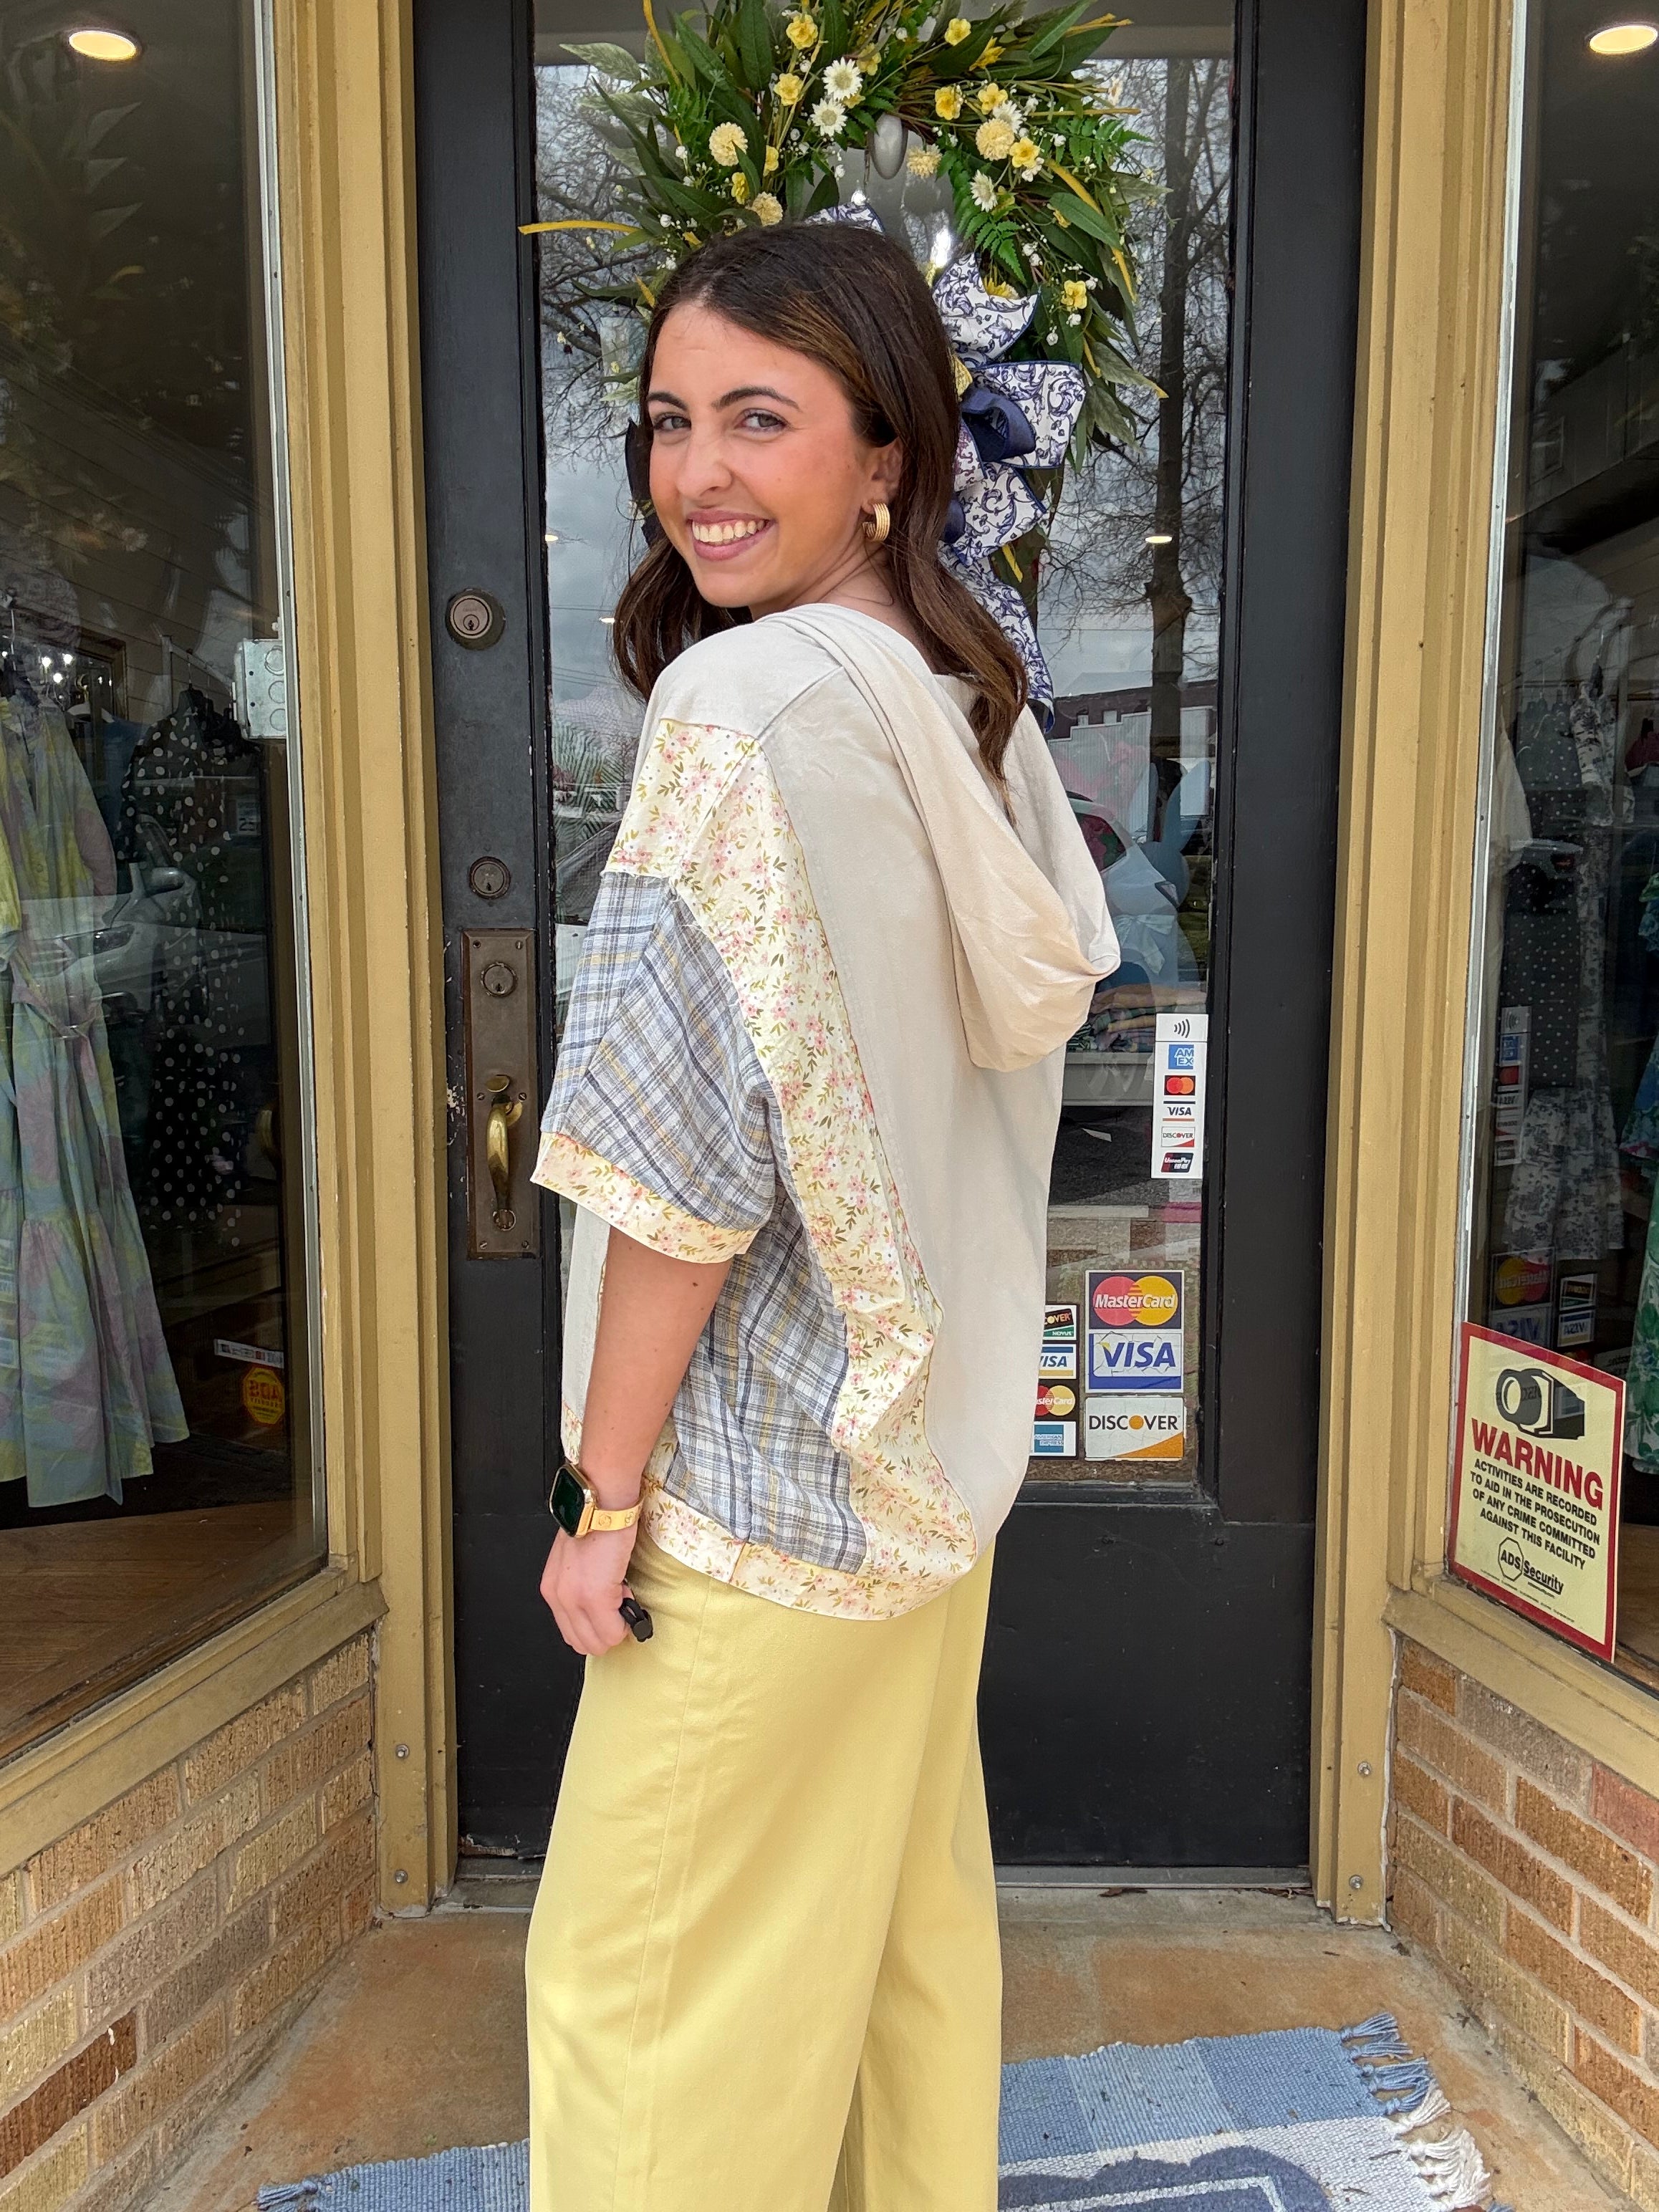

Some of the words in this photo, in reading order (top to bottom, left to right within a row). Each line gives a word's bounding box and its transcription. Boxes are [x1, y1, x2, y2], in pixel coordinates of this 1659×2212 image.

[1168, 1107, 1192, 1116] VISA
[1095, 1294, 1175, 1309] MasterCard
[1099, 1342, 1175, 1367] VISA
[1089, 1415, 1178, 1430] DISCOVER
[1471, 1418, 1605, 1510] WARNING
[1471, 1471, 1483, 1486] TO
[1484, 1478, 1499, 1494] AID
[1502, 1486, 1511, 1500] IN
[1514, 1491, 1532, 1509] THE
[1534, 1501, 1600, 1546] PROSECUTION
[1474, 1458, 1523, 1489] ACTIVITIES
[1525, 1481, 1544, 1499] ARE
[1546, 1491, 1597, 1526] RECORDED
[1473, 1488, 1485, 1501] OF
[1486, 1495, 1506, 1511] ANY
[1507, 1505, 1537, 1529] CRIME
[1539, 1521, 1596, 1559] COMMITTED
[1480, 1508, 1519, 1536] AGAINST
[1521, 1527, 1542, 1548] THIS
[1544, 1539, 1586, 1570] FACILITY
[1500, 1549, 1521, 1570] ADS
[1523, 1559, 1564, 1591] Security
